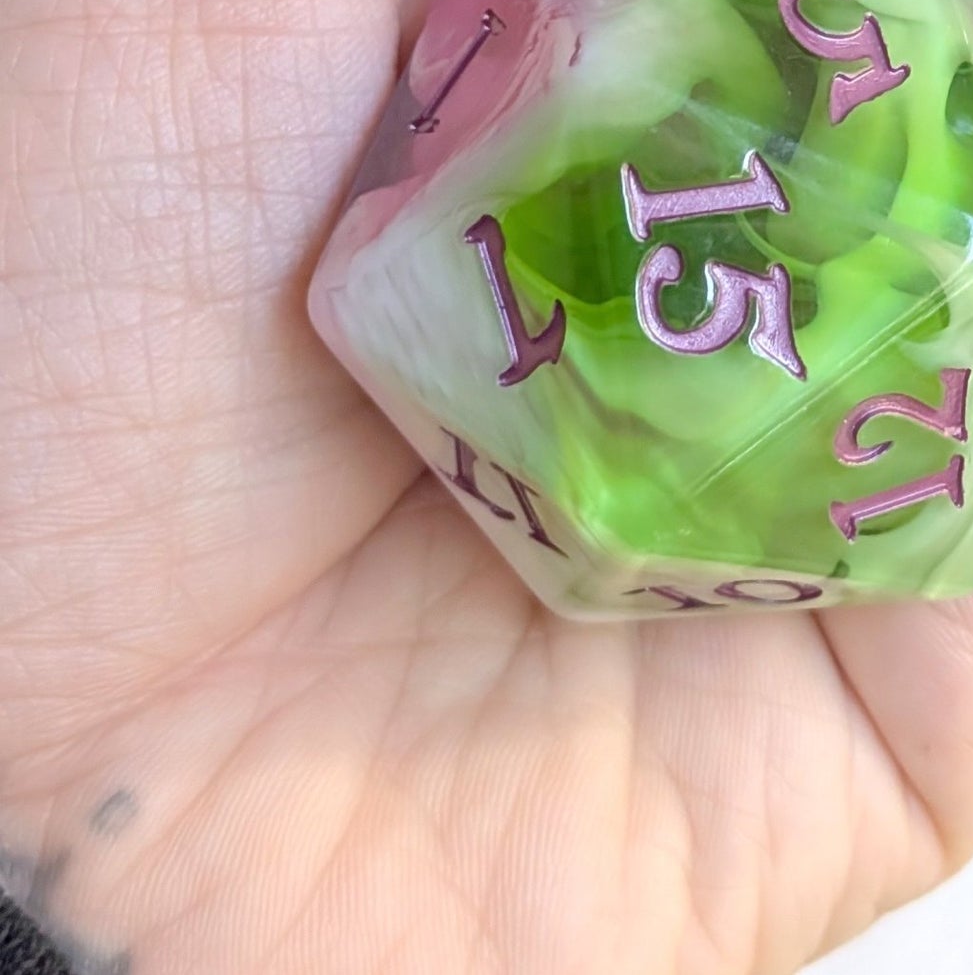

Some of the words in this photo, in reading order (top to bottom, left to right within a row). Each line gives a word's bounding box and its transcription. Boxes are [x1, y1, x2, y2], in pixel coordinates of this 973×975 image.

[621, 148, 808, 382] 15
[829, 366, 972, 544] 12
[620, 578, 824, 612] 10
